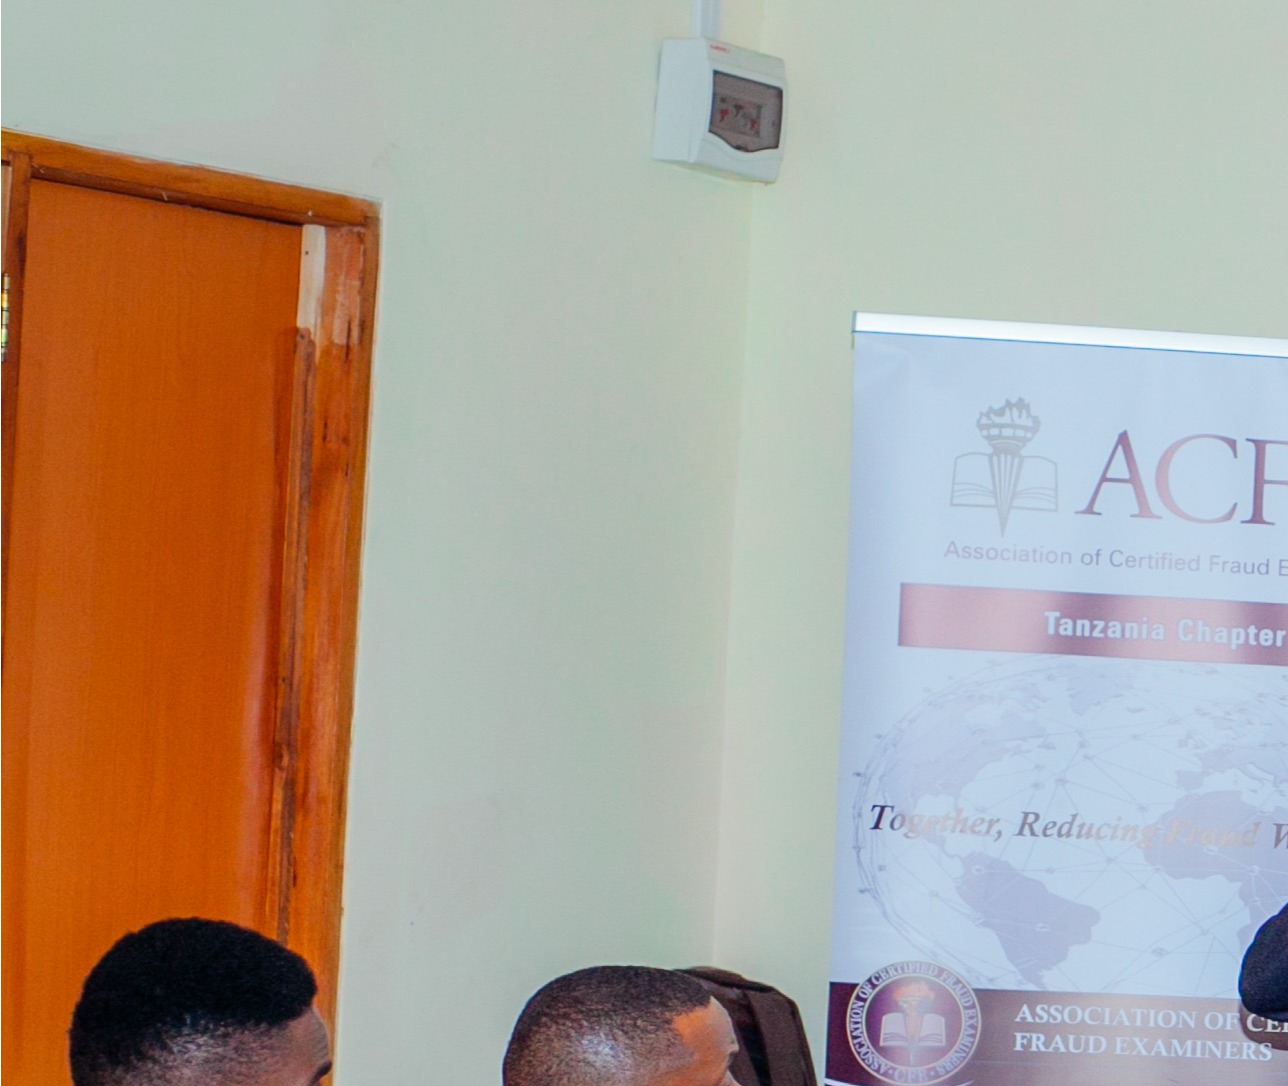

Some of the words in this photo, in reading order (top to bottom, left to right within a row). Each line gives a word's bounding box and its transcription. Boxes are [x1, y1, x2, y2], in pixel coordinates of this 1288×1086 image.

[943, 541, 1072, 564] Association
[1081, 549, 1102, 566] of
[1109, 549, 1200, 571] Certified
[1208, 555, 1270, 576] Fraud
[1044, 611, 1165, 640] Tanzania
[1178, 618, 1286, 650] Chapter
[869, 804, 1003, 842] Together,
[1014, 811, 1159, 849] Reducing
[1166, 816, 1262, 849] Fraud
[858, 983, 875, 999] OF
[871, 962, 938, 985] CERTIFIED
[1015, 1003, 1196, 1029] ASSOCIATION
[1204, 1011, 1240, 1031] OF
[850, 1000, 890, 1074] ASSOCIATION
[936, 1008, 978, 1076] EXAMINERS
[1013, 1032, 1107, 1054] FRAUD
[1115, 1036, 1273, 1062] EXAMINERS
